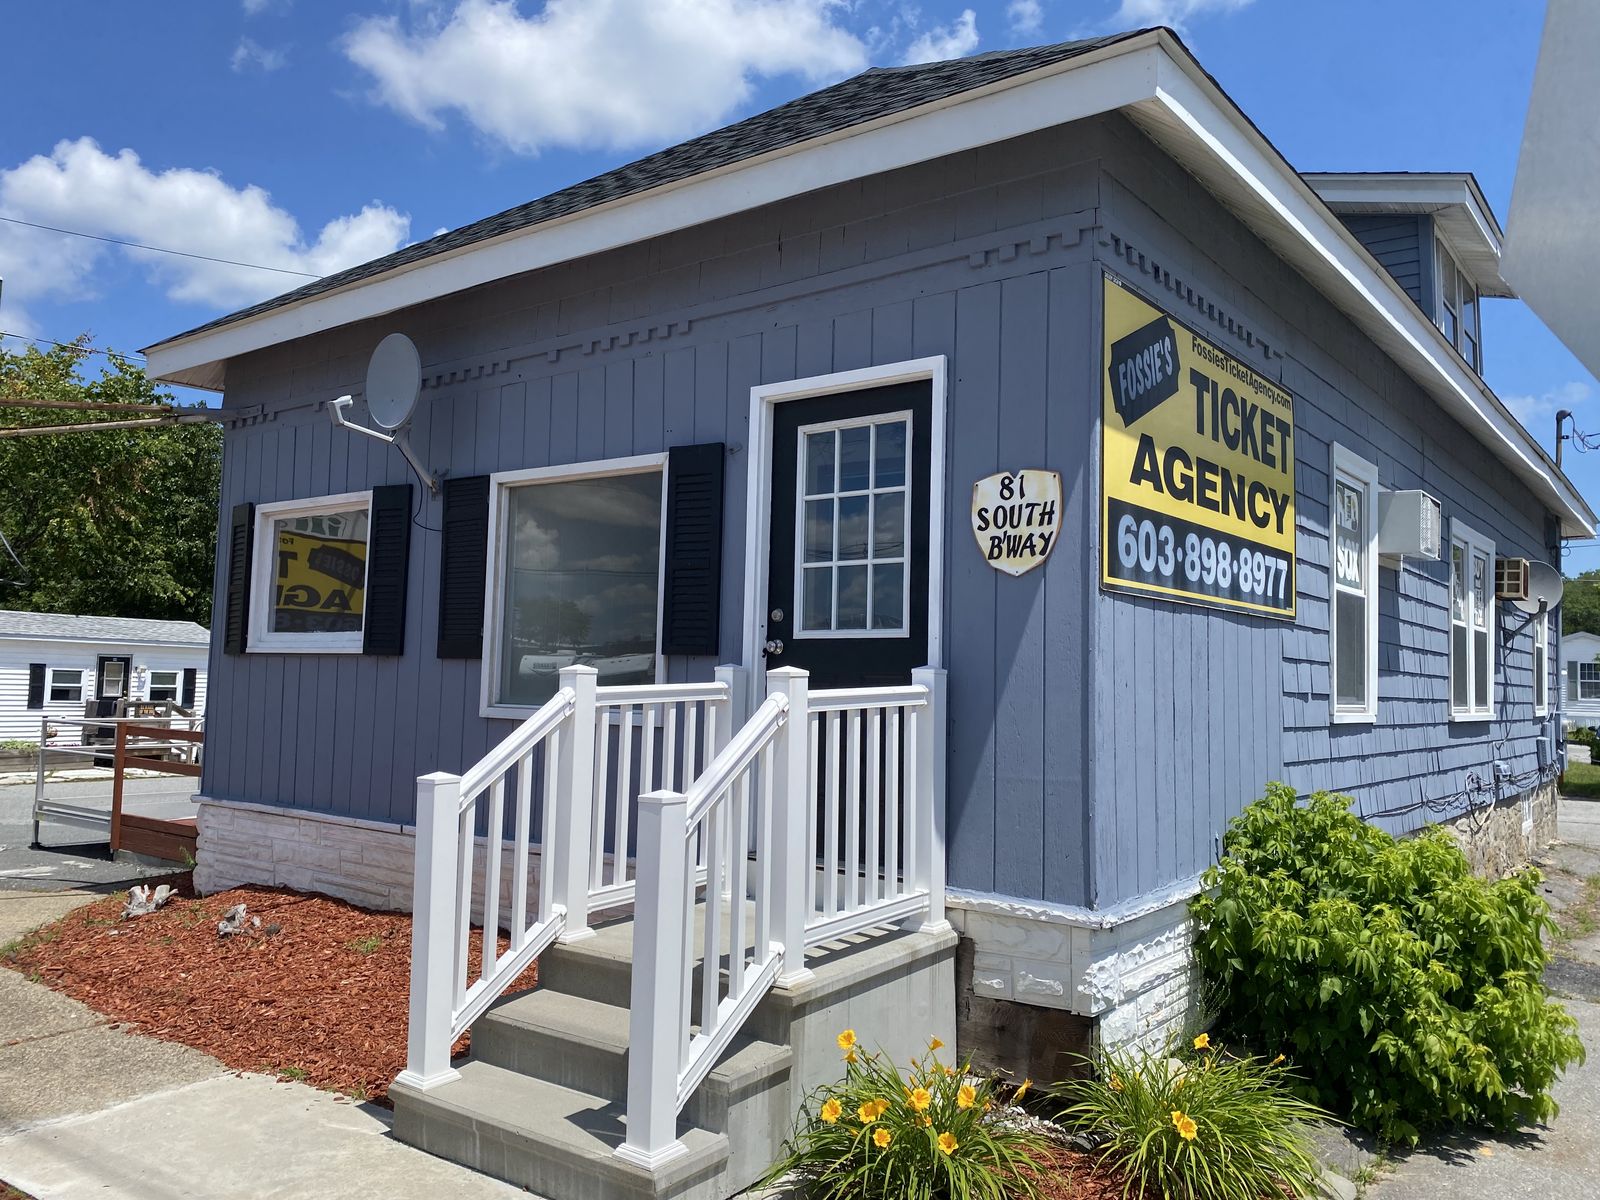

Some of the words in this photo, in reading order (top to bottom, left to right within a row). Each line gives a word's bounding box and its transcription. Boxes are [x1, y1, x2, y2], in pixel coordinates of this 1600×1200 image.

[1119, 336, 1173, 406] FOSSIE'S
[1191, 336, 1291, 411] FossiesTicketAgency.com
[1190, 367, 1291, 475] TICKET
[1000, 474, 1026, 501] 81
[1129, 433, 1290, 535] AGENCY
[977, 500, 1055, 532] SOUTH
[987, 530, 1054, 561] B'WAY
[1337, 535, 1360, 583] SOX
